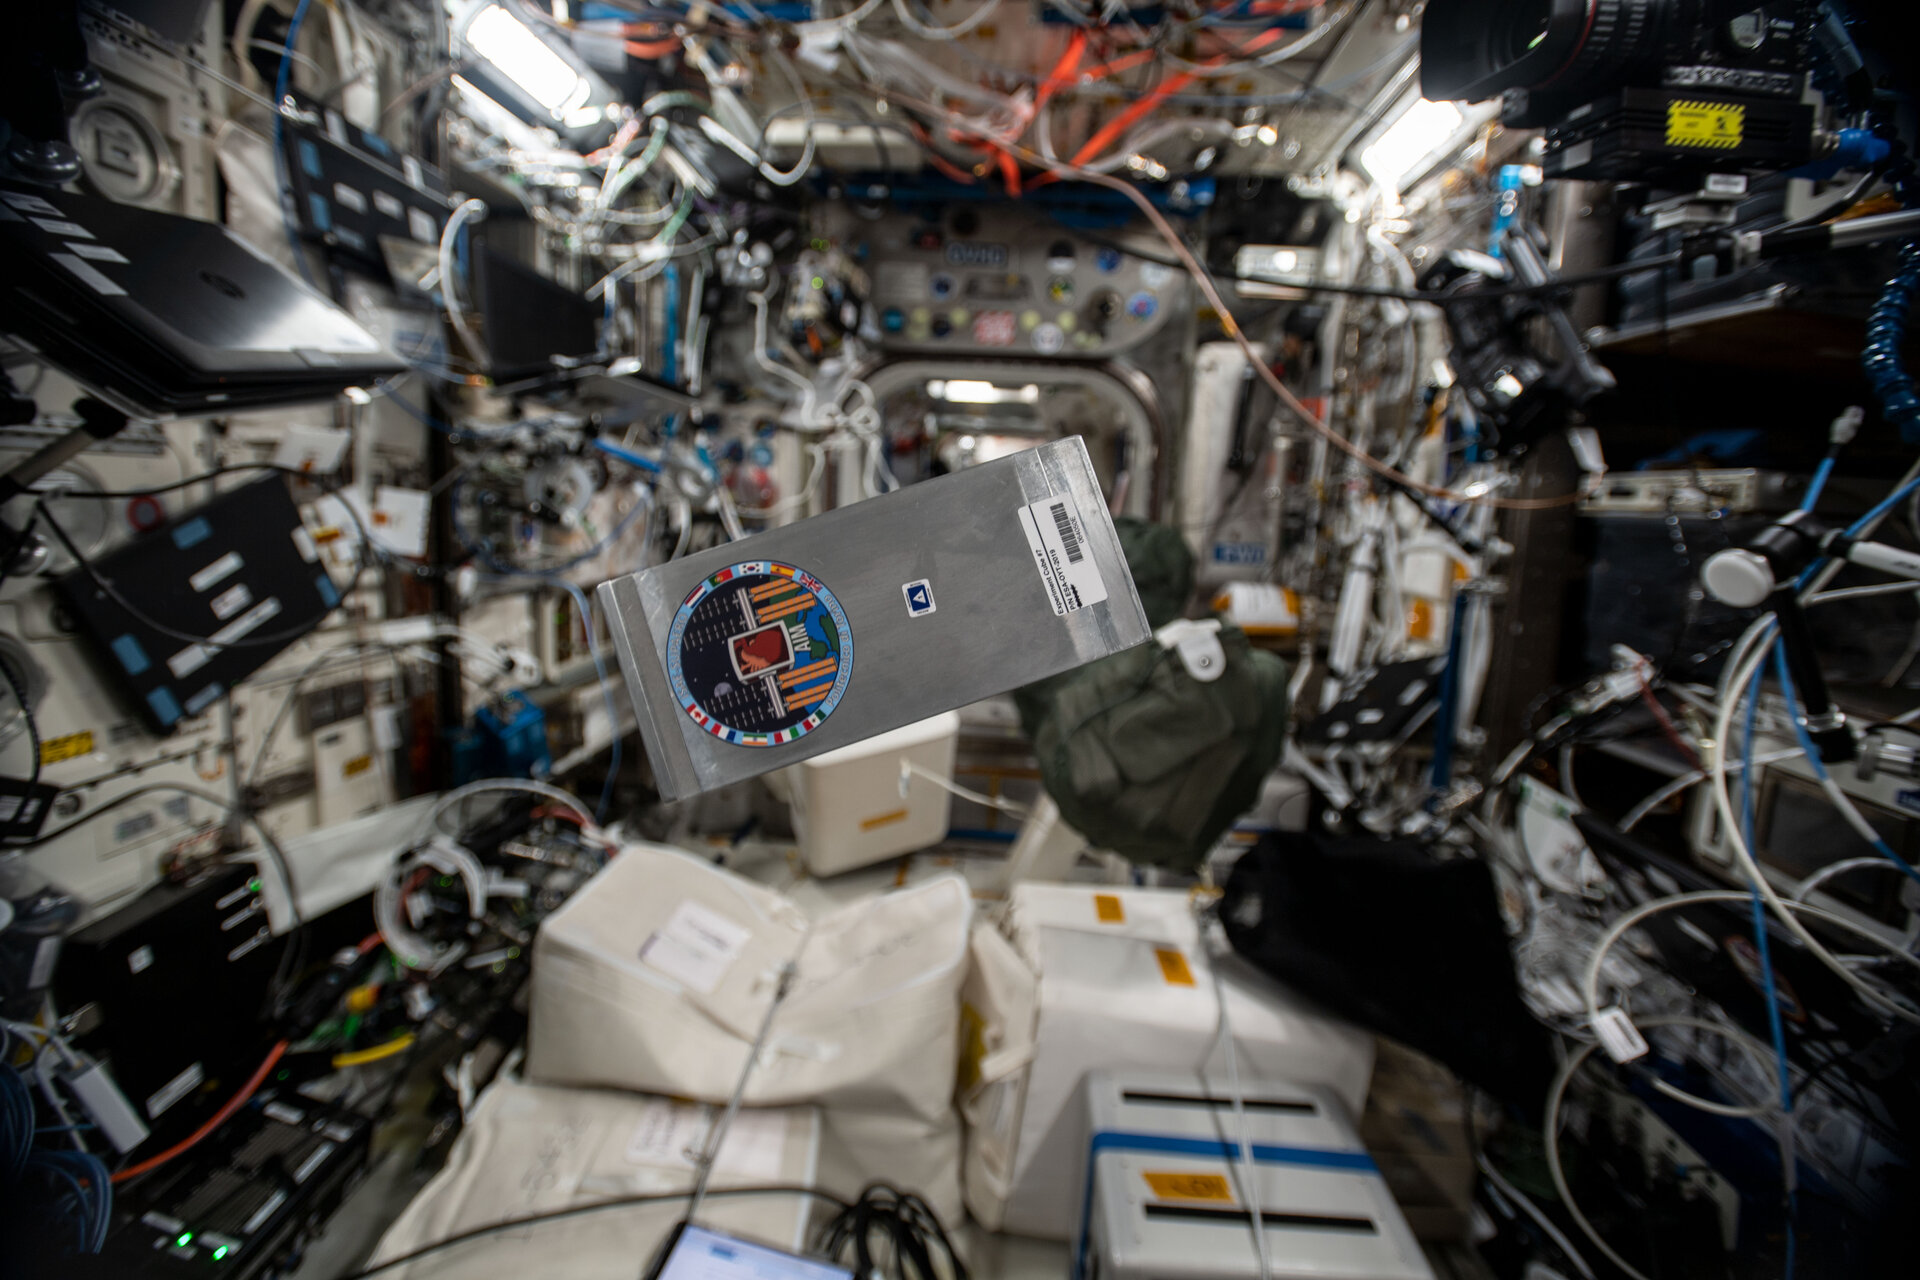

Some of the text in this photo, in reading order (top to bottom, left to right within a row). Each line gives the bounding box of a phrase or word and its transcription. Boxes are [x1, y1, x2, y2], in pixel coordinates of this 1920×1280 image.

[1035, 549, 1064, 615] Experiment Cube #7
[1049, 549, 1076, 611] P/N ESA-OYT-2019
[670, 613, 690, 700] ISAE-SUPAERO
[788, 623, 811, 652] AIM
[824, 593, 851, 708] Politecnico di Torino
